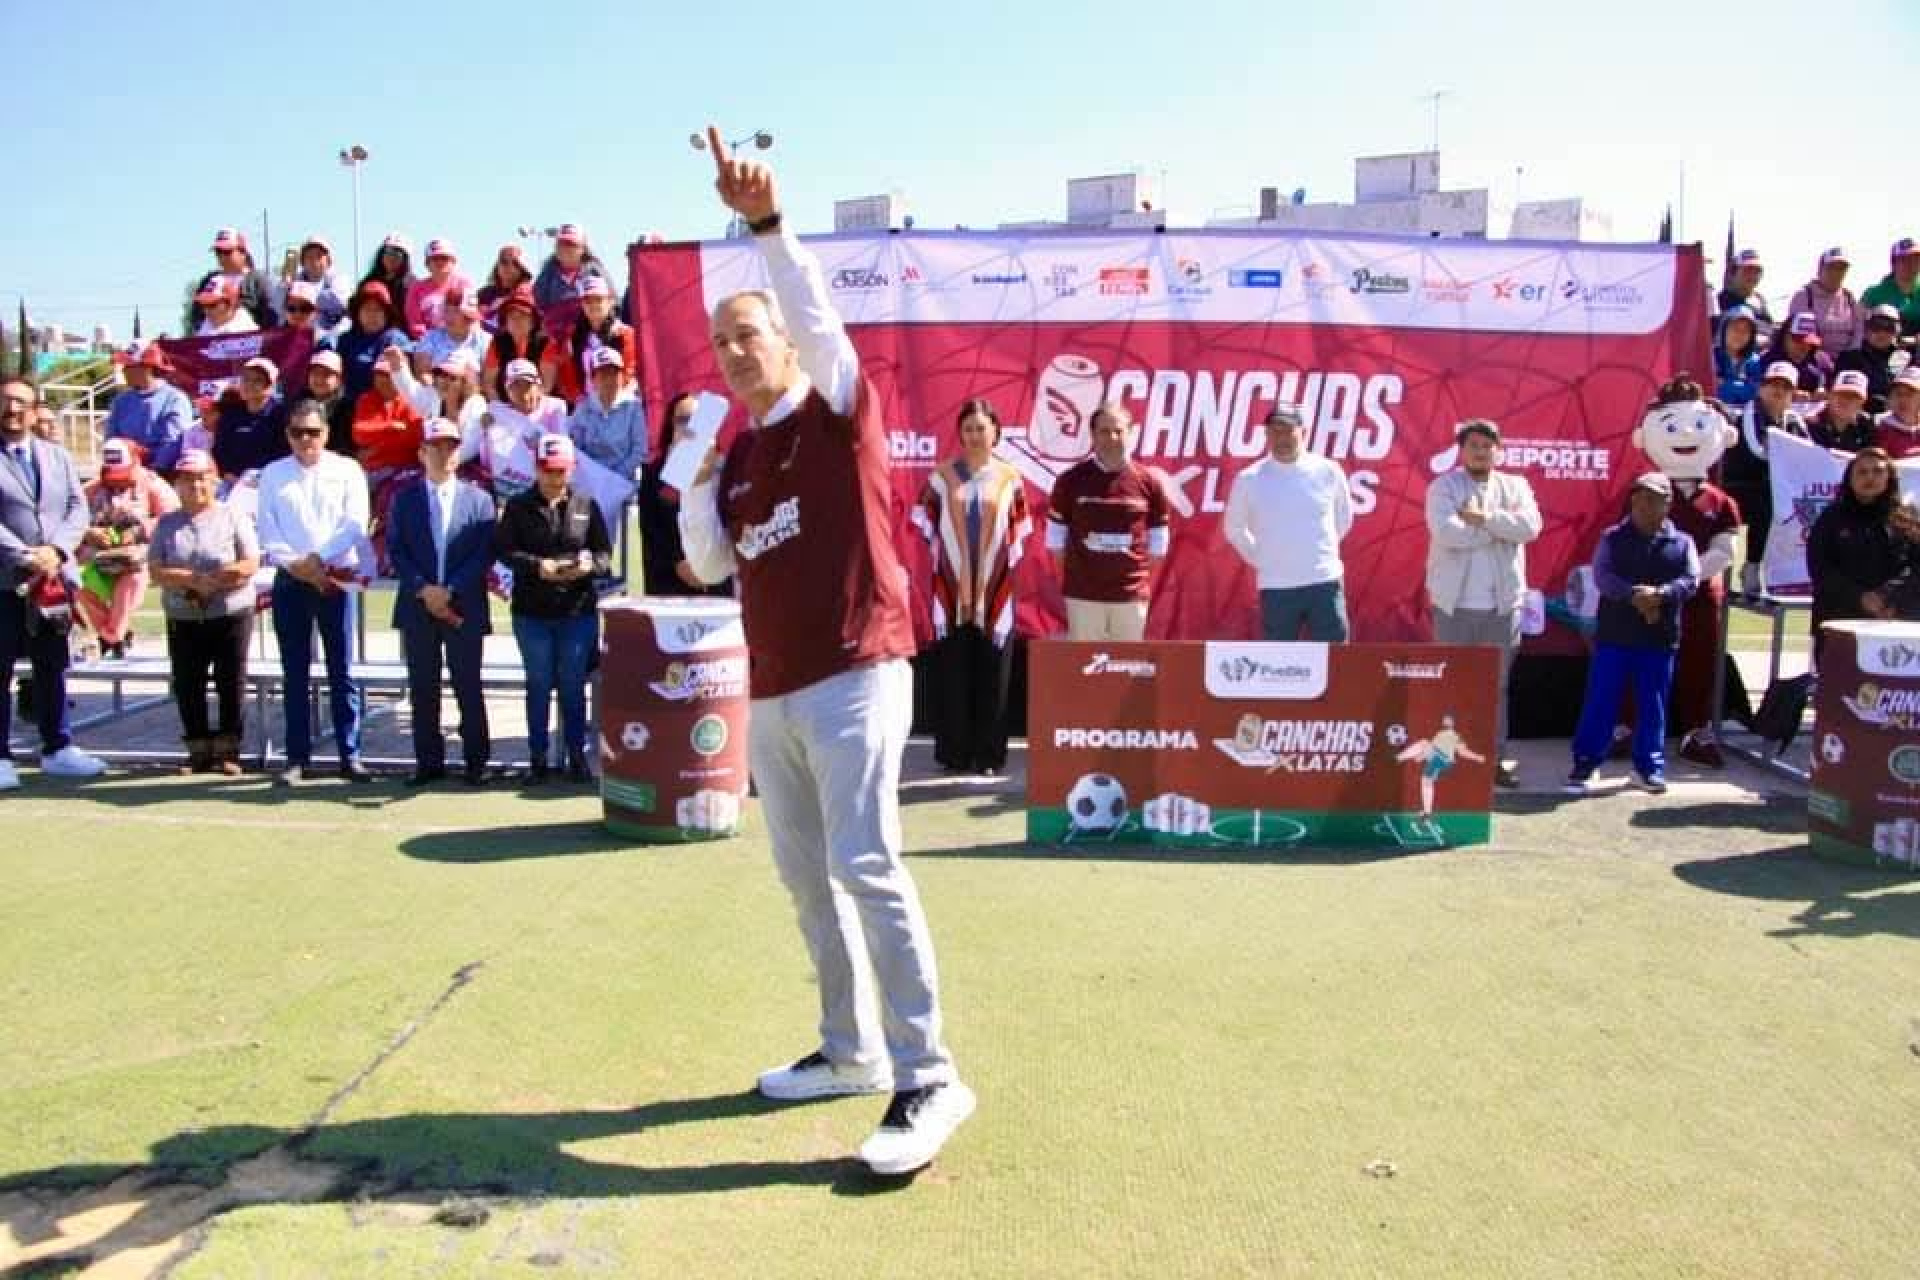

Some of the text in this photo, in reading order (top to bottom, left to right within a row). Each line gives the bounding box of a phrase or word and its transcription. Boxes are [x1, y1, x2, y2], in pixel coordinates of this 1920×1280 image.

[1104, 369, 1404, 460] CANCHAS
[1054, 727, 1199, 749] PROGRAMA
[1261, 720, 1375, 753] CANCHAS
